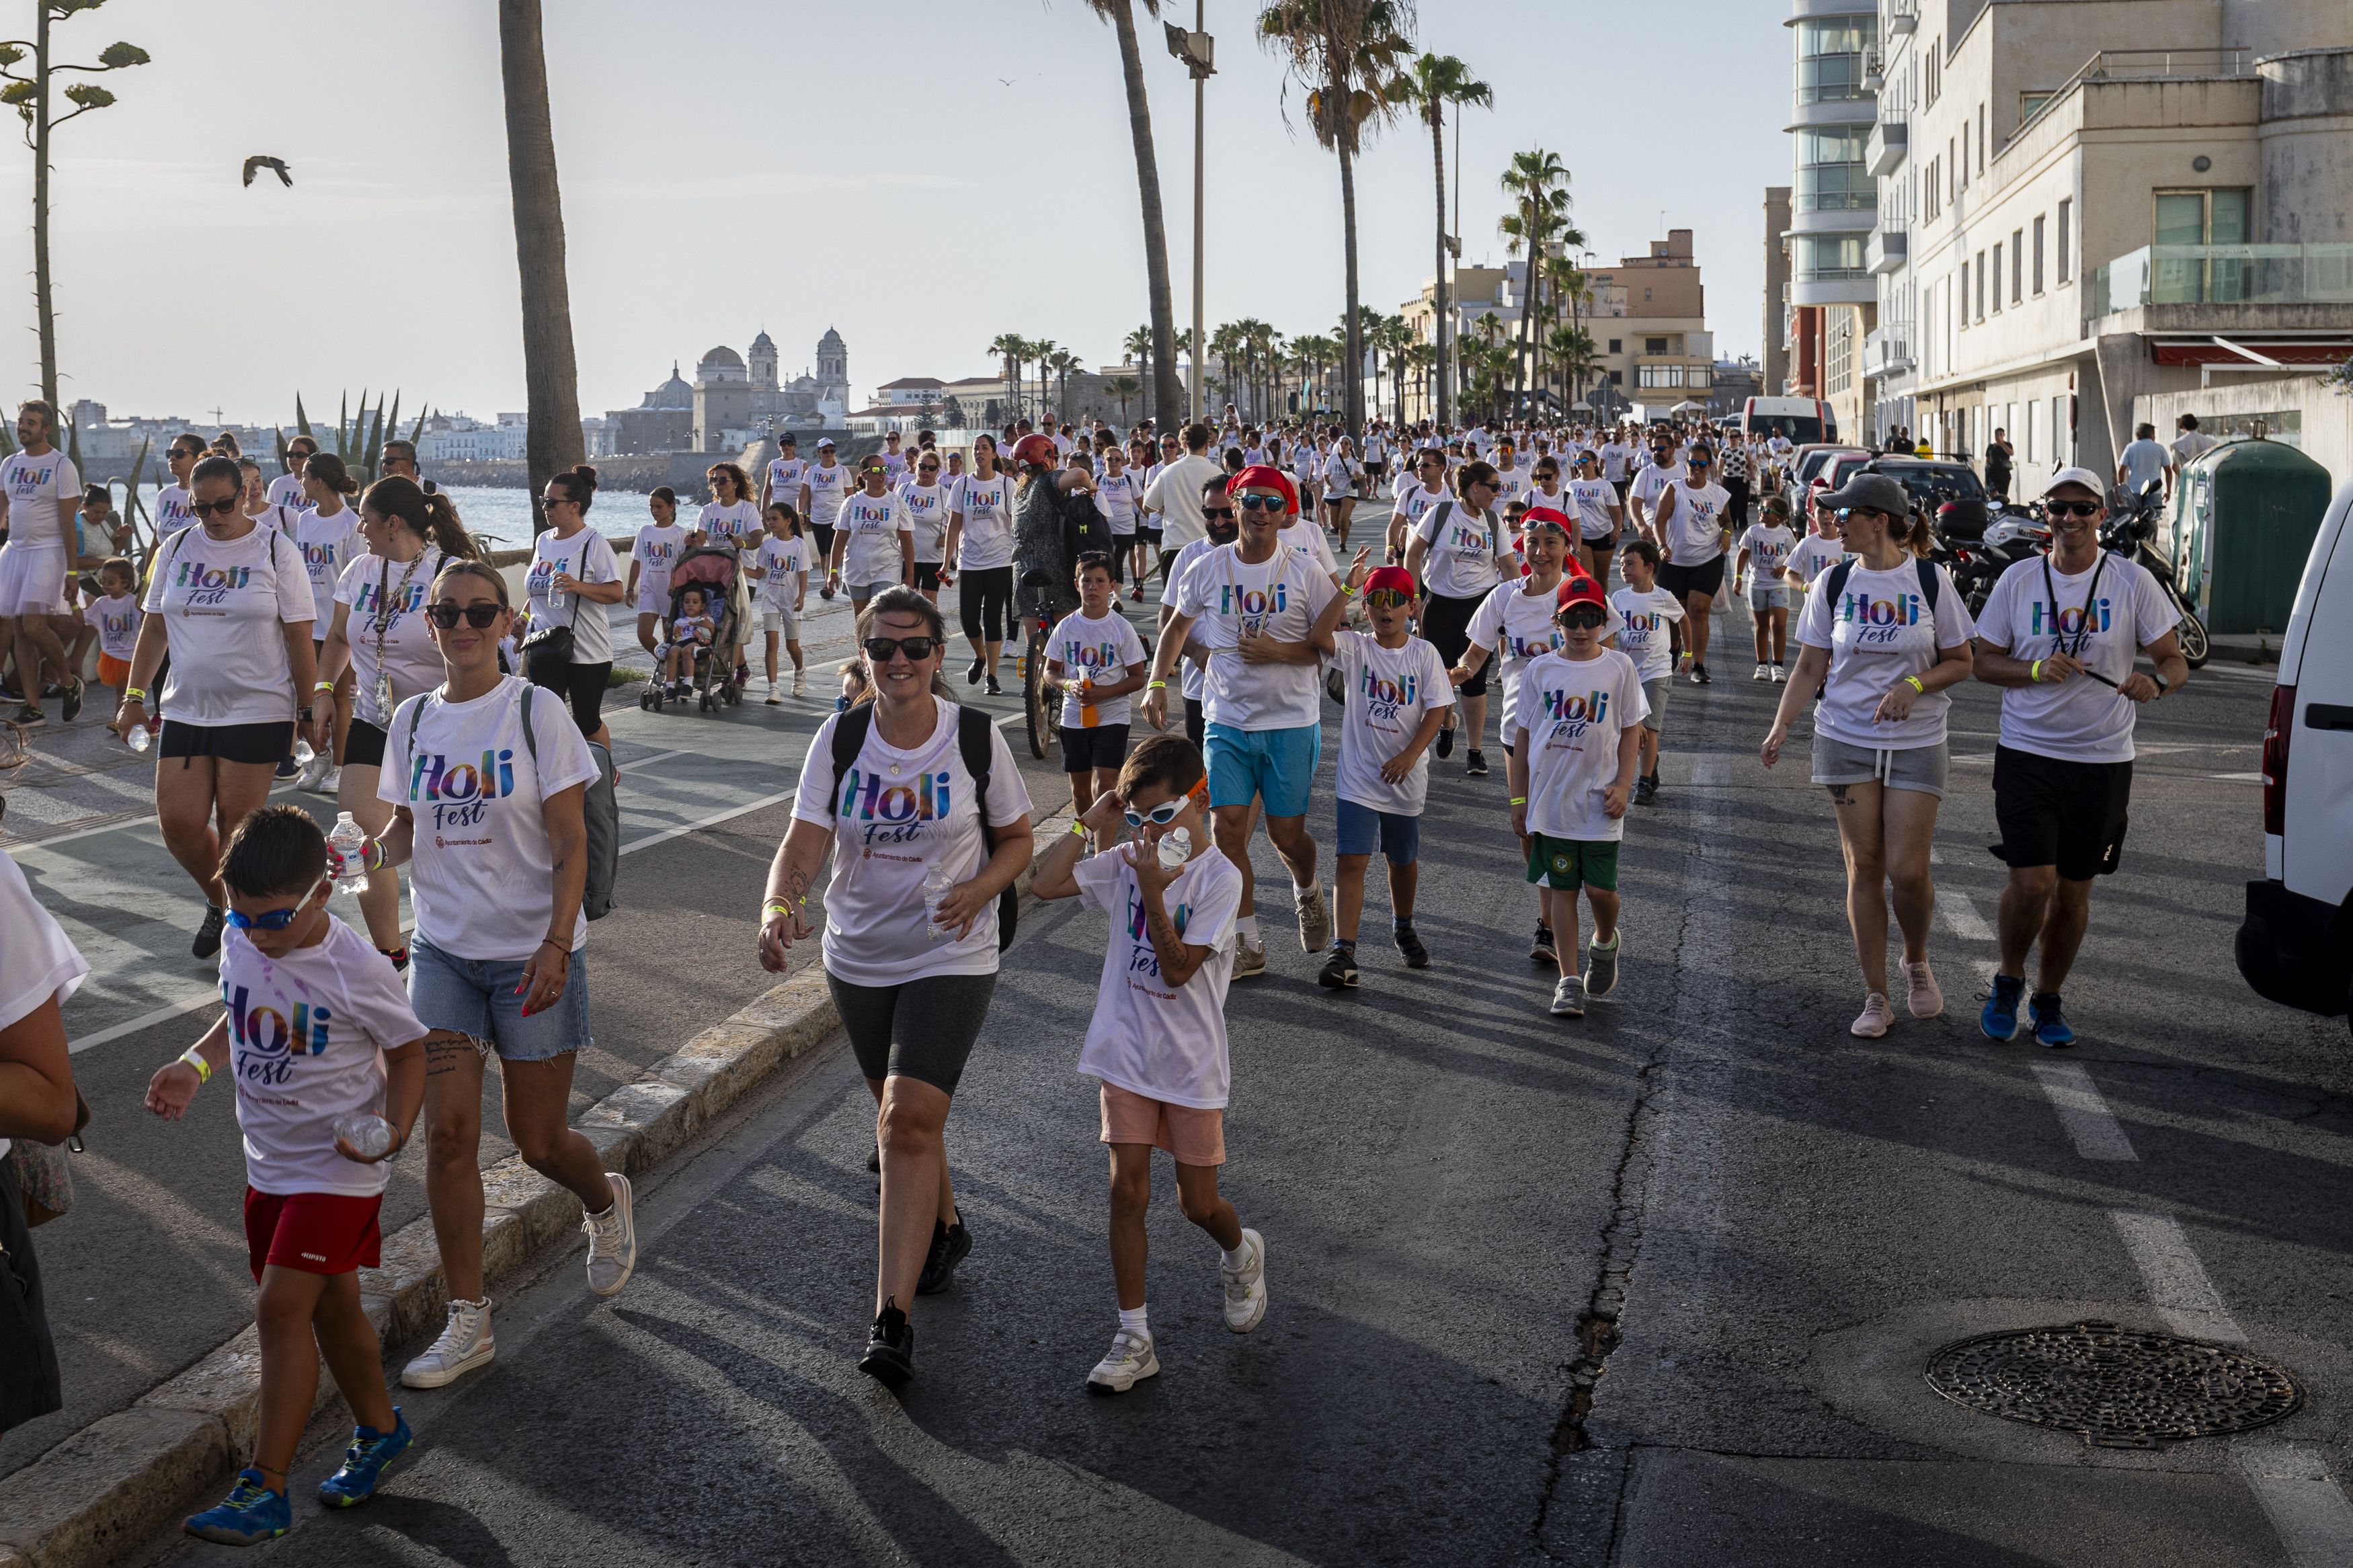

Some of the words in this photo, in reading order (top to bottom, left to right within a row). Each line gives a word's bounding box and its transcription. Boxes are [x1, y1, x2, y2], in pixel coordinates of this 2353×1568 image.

[1515, 455, 1530, 463] Holi
[9, 466, 52, 485] Holi
[773, 468, 797, 479] Holi
[813, 472, 836, 483] Holi
[16, 484, 36, 495] Fest
[1498, 481, 1518, 493] oli
[1574, 488, 1599, 497] Holi
[905, 494, 934, 509] Holi
[965, 491, 1000, 506] Holi
[854, 506, 890, 522] Holi
[973, 505, 992, 515] Fest
[165, 517, 186, 528] Fest
[707, 518, 742, 534] Holi
[861, 520, 881, 530] Fest
[1450, 526, 1492, 550] Holi
[644, 541, 672, 559] Holi
[1458, 548, 1484, 558] Fest
[1754, 540, 1784, 556] Holi
[647, 557, 664, 567] Fest
[767, 553, 797, 572] Holi
[1759, 556, 1776, 565] Fest
[176, 562, 250, 589] Holi
[768, 571, 786, 579] Fest
[186, 587, 229, 606] Fest
[1221, 583, 1287, 614] Holi
[1843, 591, 1919, 626] Holi
[2032, 597, 2111, 636] Holi
[1620, 610, 1661, 632] Holi
[1627, 631, 1650, 643] Fest
[1856, 625, 1901, 644] Fest
[1065, 641, 1115, 667] Holi
[1361, 665, 1416, 706] Holi
[1367, 700, 1401, 720] Fest
[1544, 689, 1609, 724] Holi
[1550, 720, 1589, 739] Fest
[409, 748, 515, 802] Holi
[842, 768, 951, 821] Holi
[430, 798, 489, 831] Fest
[444, 837, 471, 847] Ayuntamiento
[478, 837, 493, 845] Cádiz
[863, 821, 925, 845] Fest
[872, 851, 902, 862] Ayuntamiento
[1129, 944, 1160, 977] Fes
[223, 980, 332, 1058] Holi
[237, 1048, 297, 1085] Fest
[303, 1251, 327, 1263] KIPSTA
